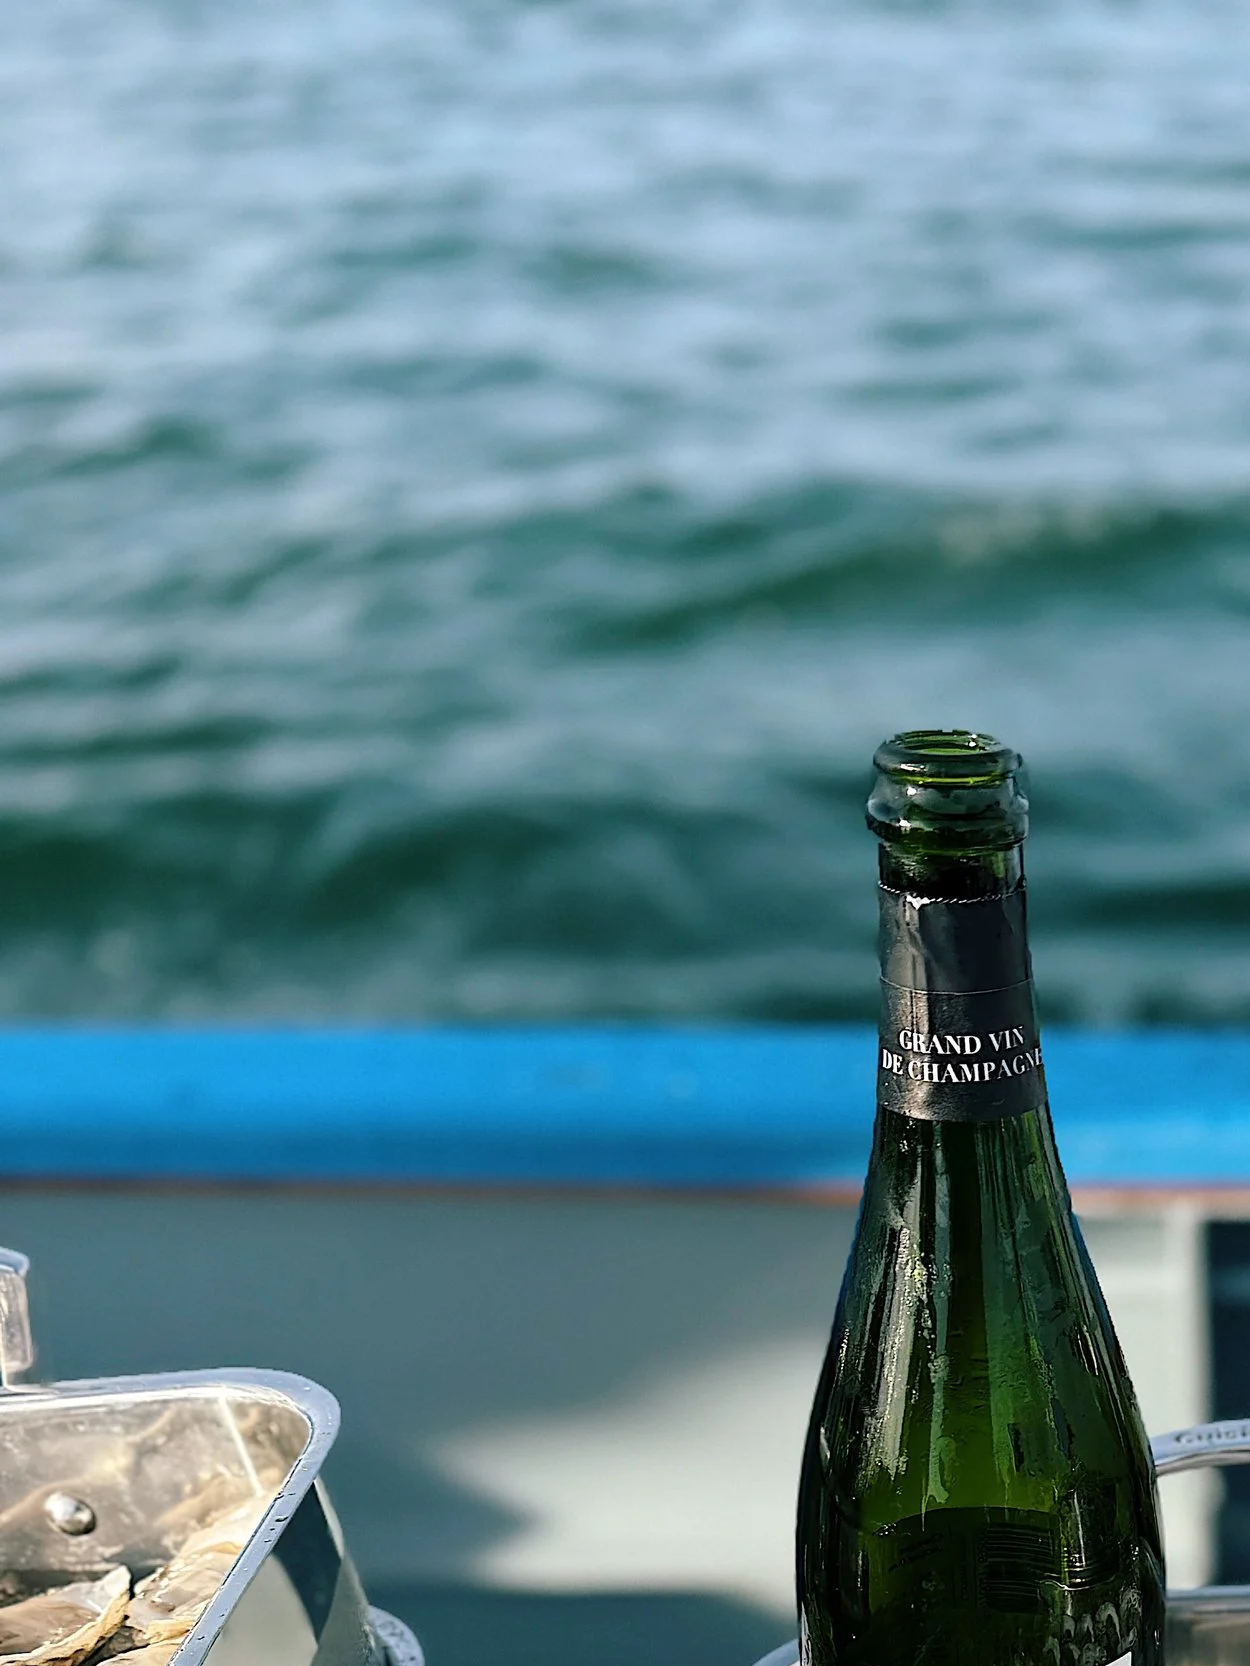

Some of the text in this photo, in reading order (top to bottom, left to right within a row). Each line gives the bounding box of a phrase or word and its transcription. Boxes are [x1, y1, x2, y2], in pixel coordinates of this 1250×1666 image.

[900, 1026, 1025, 1055] GRAND VIN
[882, 1048, 1043, 1083] DE CHAMPAGNE
